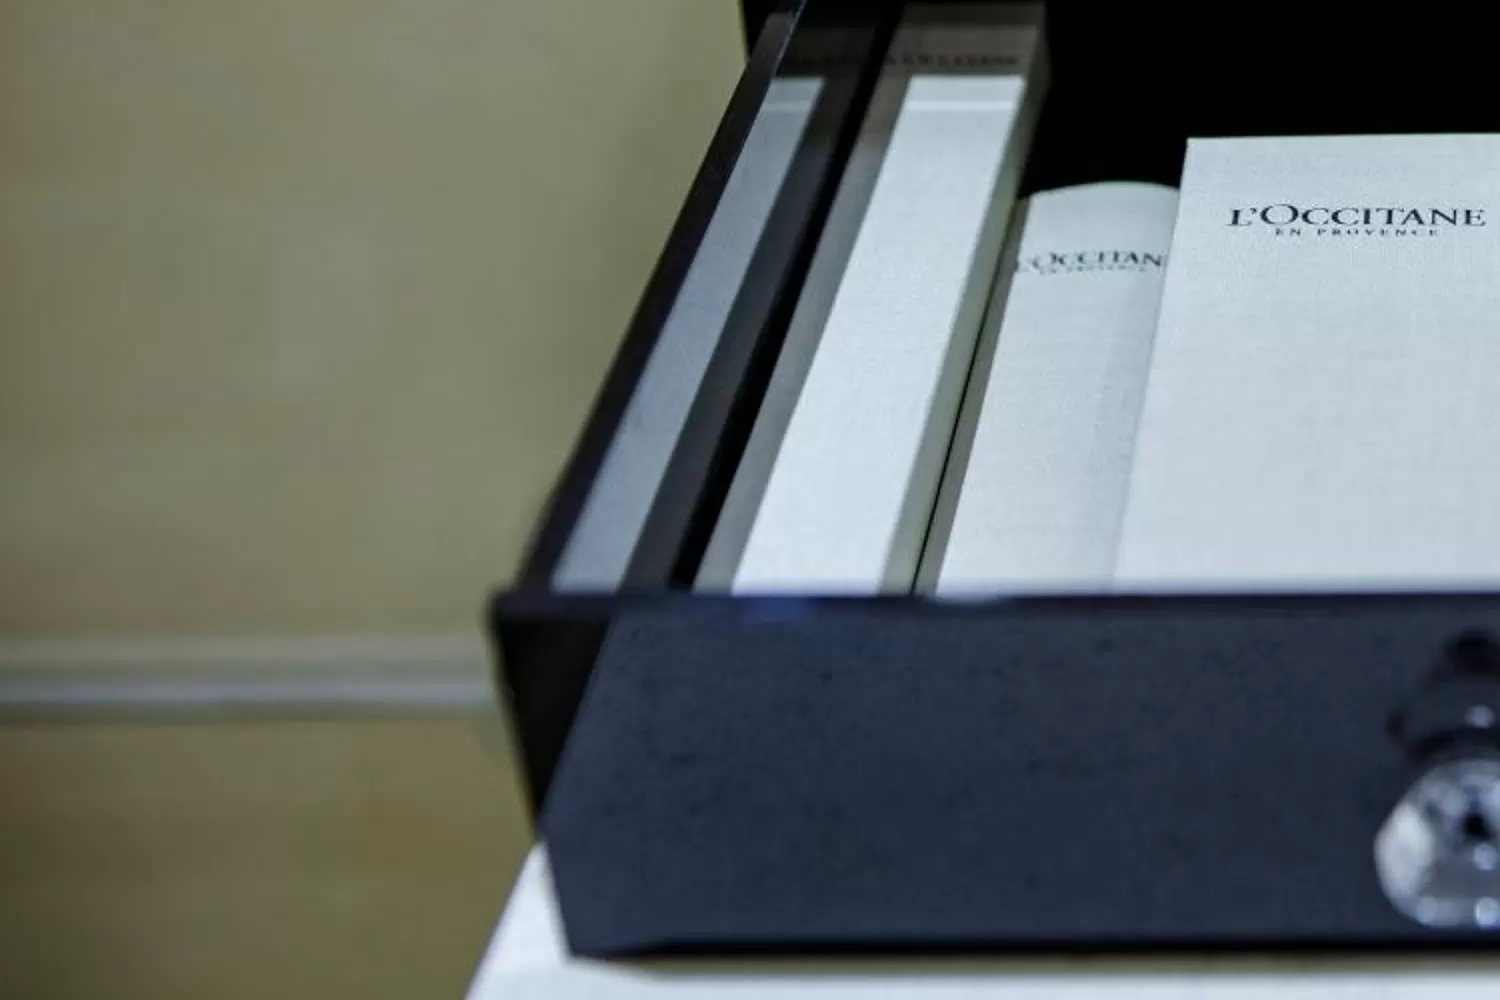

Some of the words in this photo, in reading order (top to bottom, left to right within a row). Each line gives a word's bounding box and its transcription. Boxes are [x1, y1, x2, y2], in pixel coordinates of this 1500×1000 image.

[1226, 203, 1487, 227] L'OCCITANE
[1275, 228, 1301, 237] EN
[1317, 227, 1439, 237] PROVENCE
